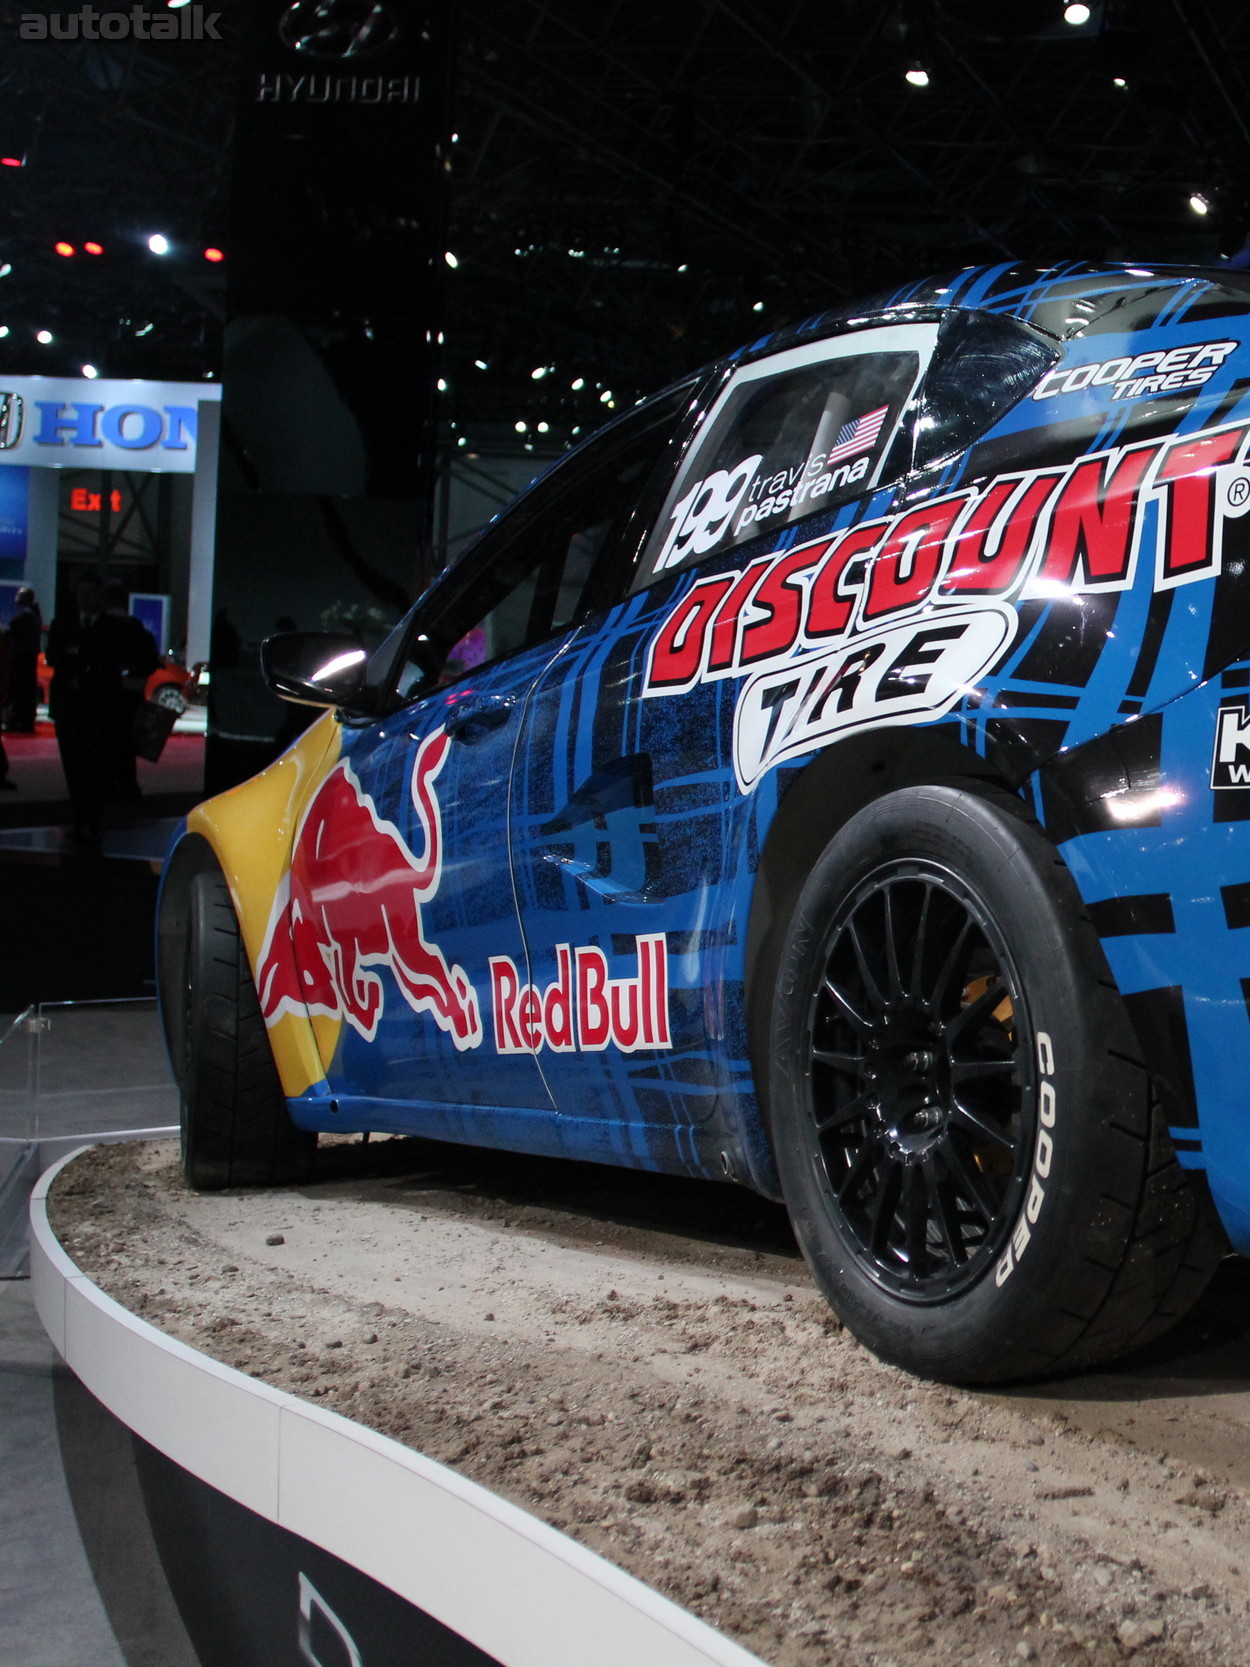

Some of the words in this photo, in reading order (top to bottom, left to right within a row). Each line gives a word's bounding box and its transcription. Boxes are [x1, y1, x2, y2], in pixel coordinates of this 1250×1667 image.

[1033, 340, 1238, 401] COOPER
[1111, 365, 1219, 400] TIRES
[70, 488, 122, 513] Ext
[733, 456, 869, 537] pastrana
[748, 452, 827, 503] travis
[652, 454, 763, 574] 199
[755, 619, 969, 764] TIRE
[996, 1032, 1056, 1287] COOPER
